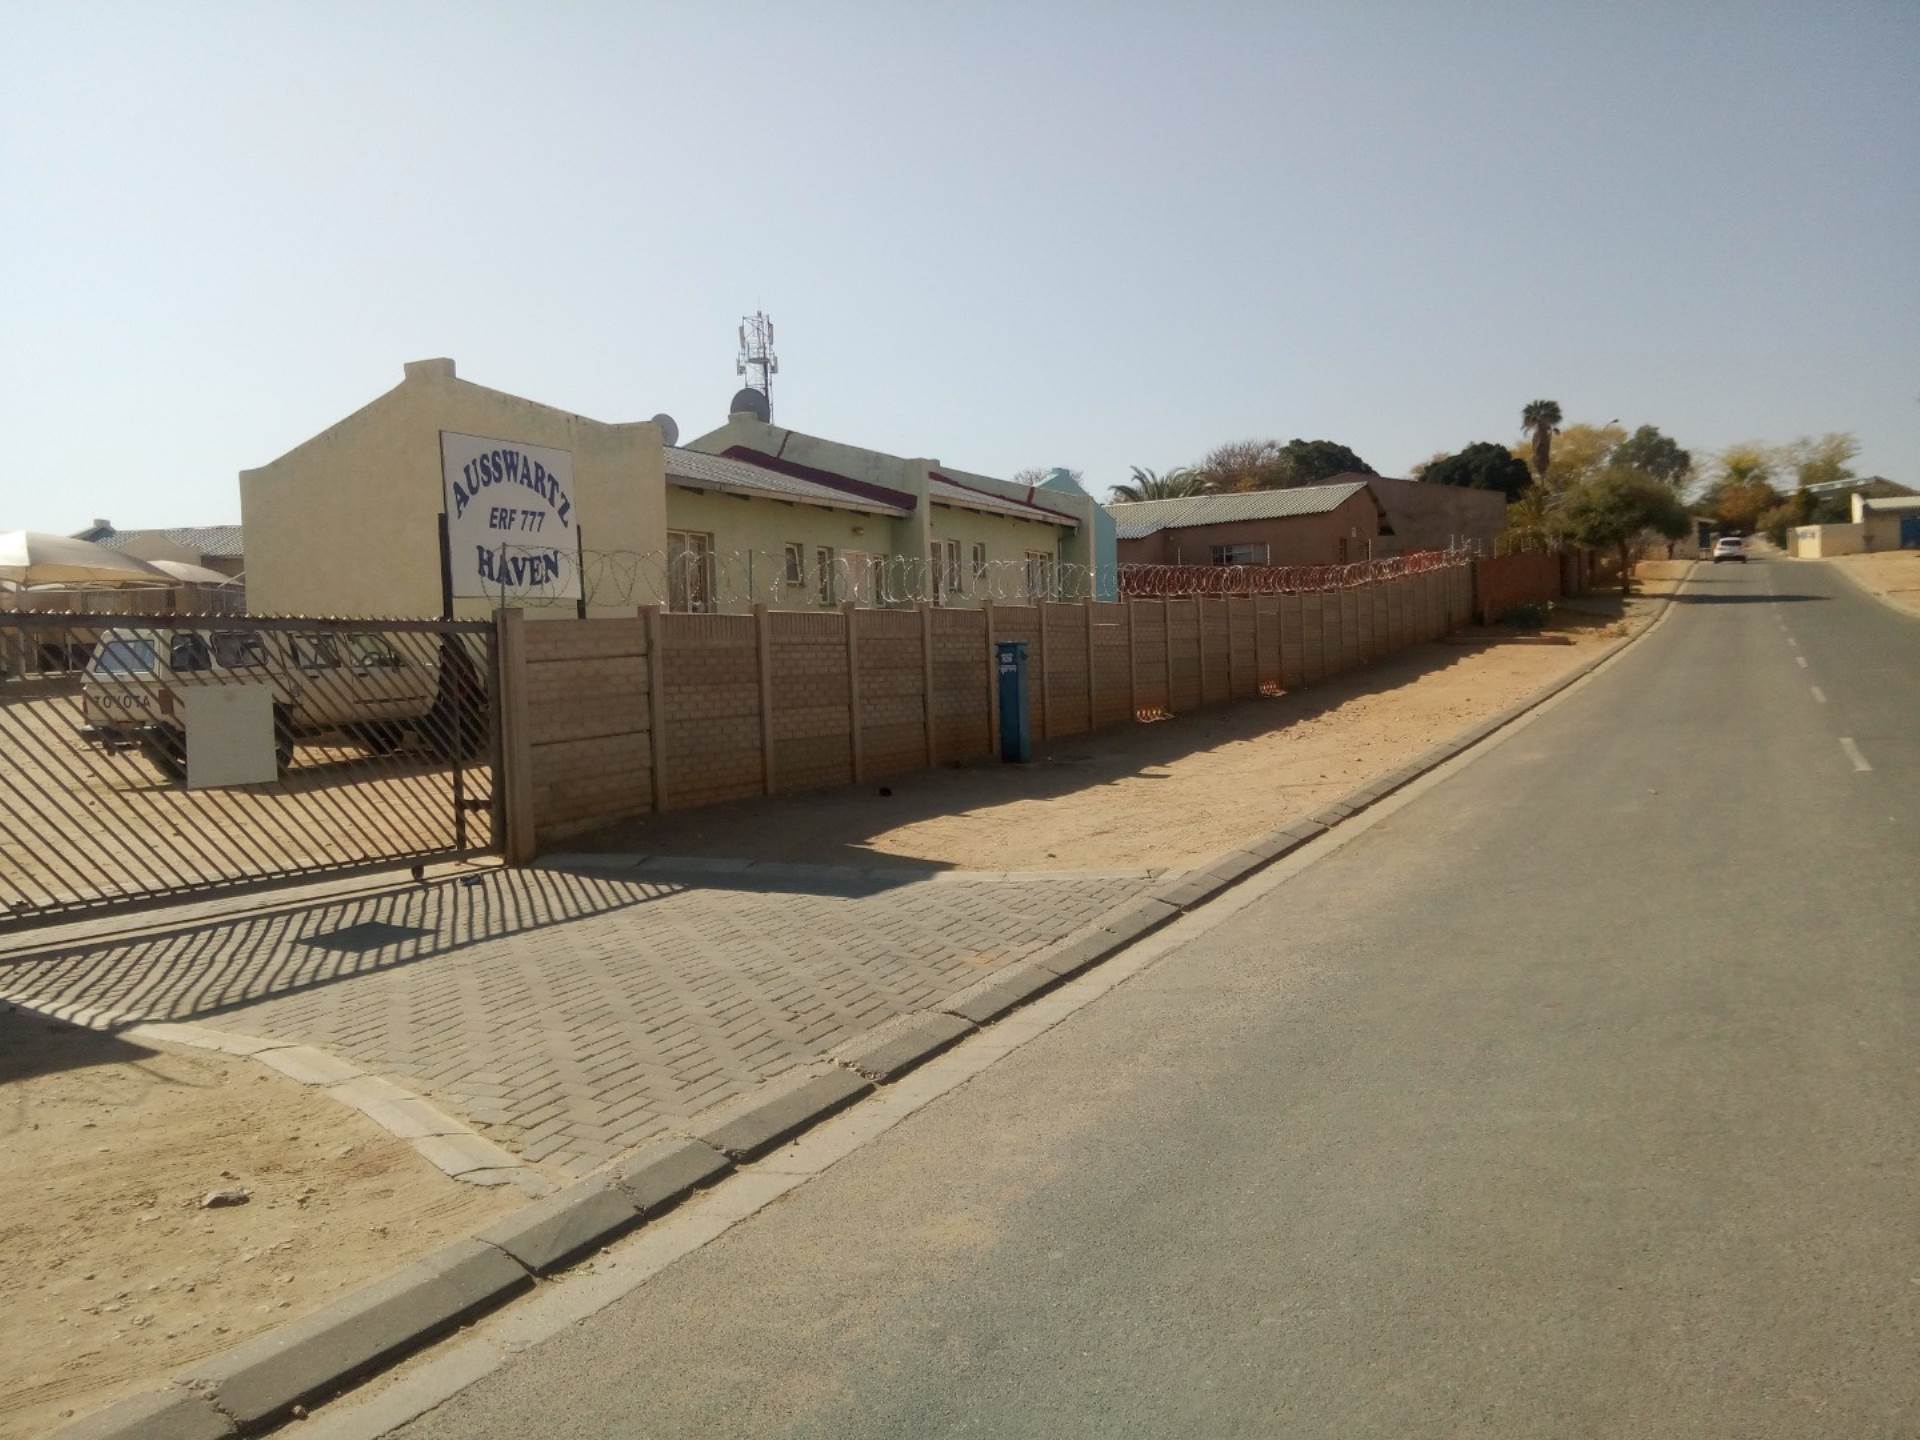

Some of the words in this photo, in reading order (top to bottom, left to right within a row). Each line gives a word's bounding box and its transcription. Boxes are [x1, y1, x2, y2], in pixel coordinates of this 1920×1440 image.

[452, 449, 570, 528] AUSSWARTZ
[489, 507, 516, 530] ERF
[520, 510, 546, 532] 777
[476, 545, 559, 586] HAVEN
